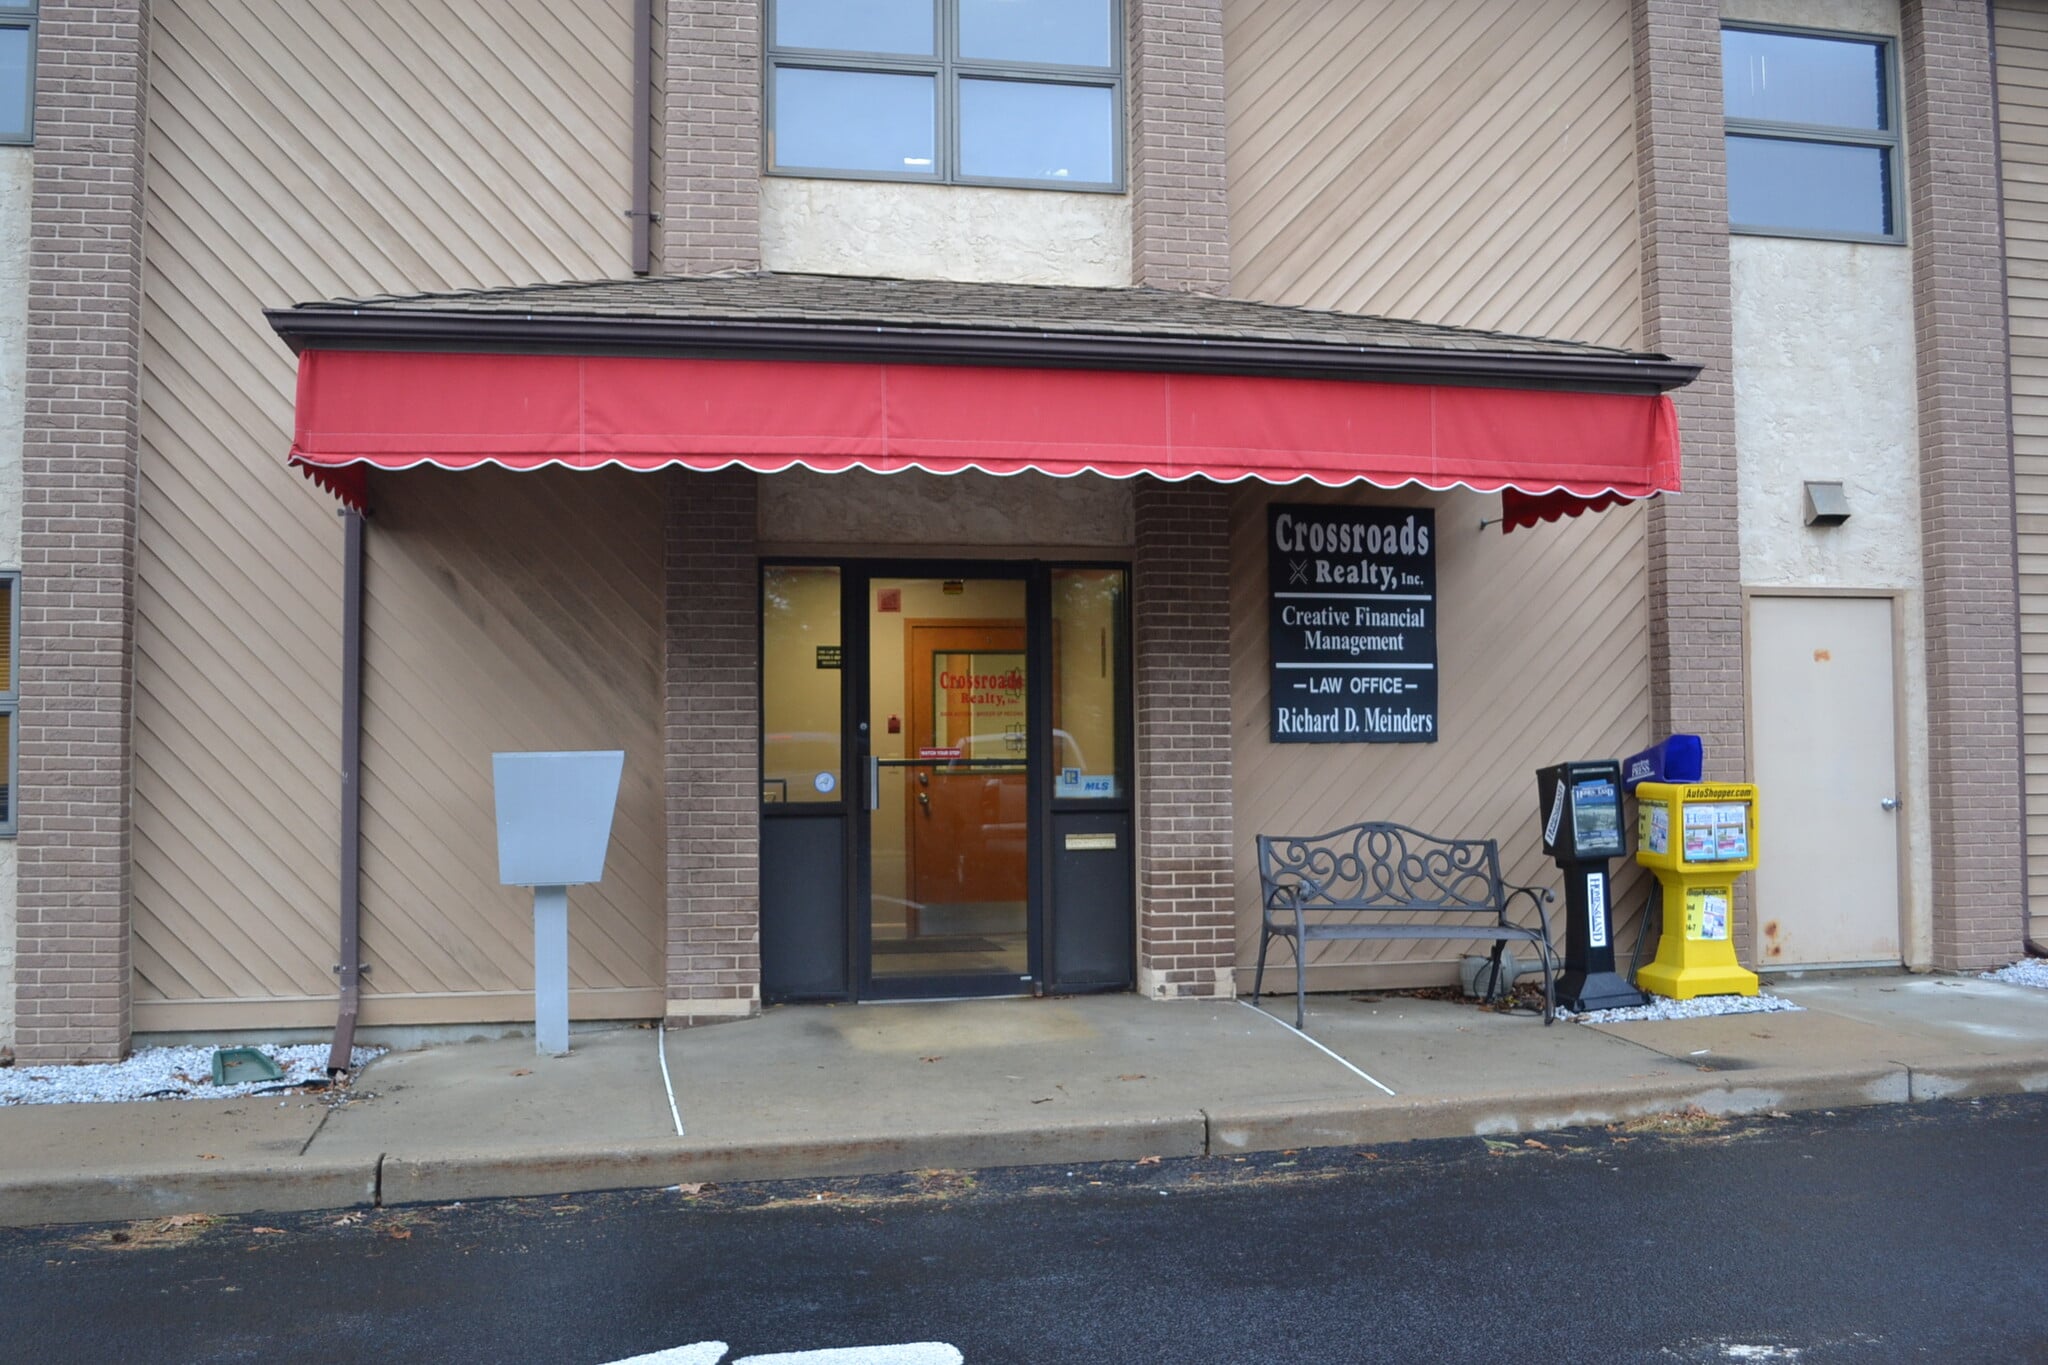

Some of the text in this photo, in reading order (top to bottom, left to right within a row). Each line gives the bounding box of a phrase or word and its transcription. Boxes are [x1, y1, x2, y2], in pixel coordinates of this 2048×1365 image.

[1275, 513, 1429, 555] Crossroads
[1315, 559, 1424, 591] Realty, Inc.
[1282, 605, 1425, 628] Creative Financial
[1304, 630, 1404, 655] Management
[940, 671, 1024, 689] Crossroads
[960, 692, 1006, 707] Realty,
[1278, 707, 1433, 733] Richard D. Meinders
[1084, 782, 1109, 791] MLS
[1686, 788, 1752, 799] AutoShopper.com
